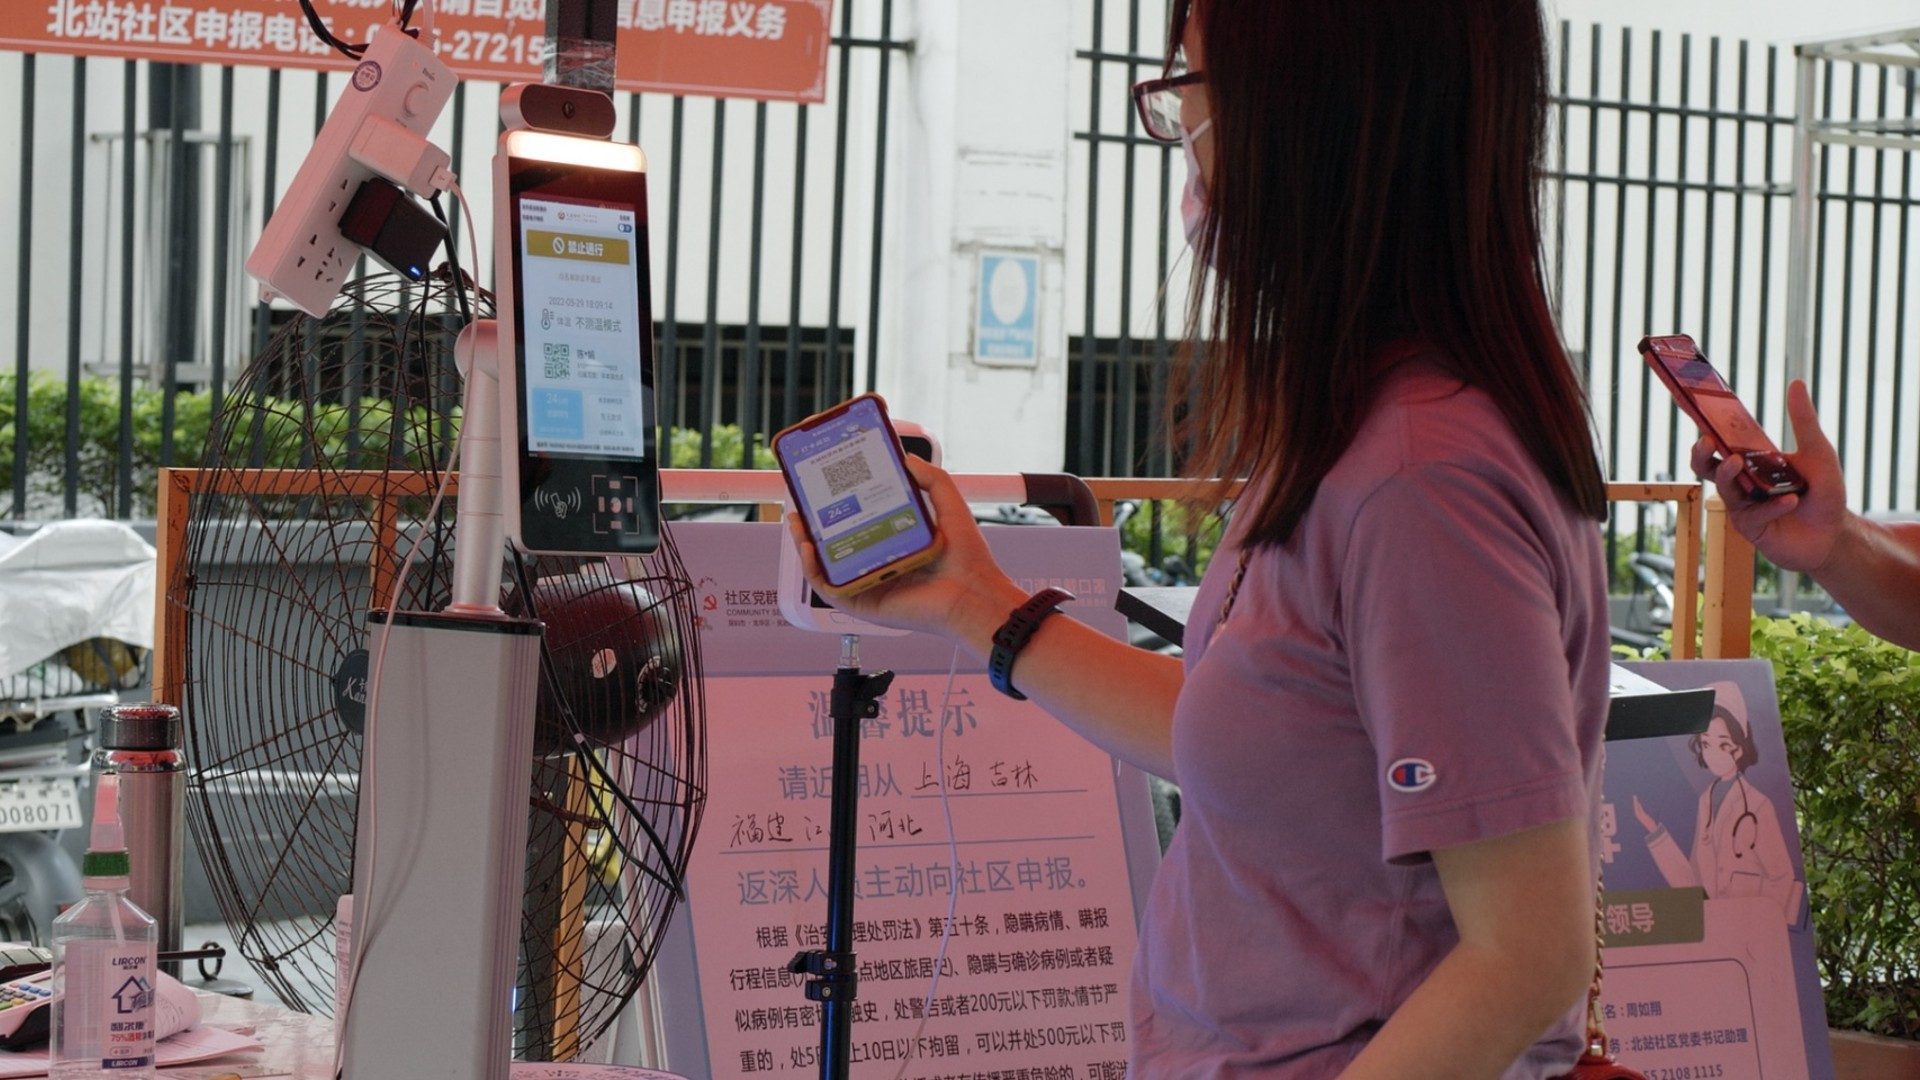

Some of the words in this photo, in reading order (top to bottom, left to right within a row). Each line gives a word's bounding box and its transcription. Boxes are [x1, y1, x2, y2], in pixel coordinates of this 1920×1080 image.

[726, 608, 770, 616] COMMUNITY
[914, 754, 971, 790] 上海
[989, 760, 1038, 789] 吉林
[730, 812, 794, 848] 福建
[868, 810, 923, 842] 河北
[112, 956, 146, 966] LIRCON
[1662, 1067, 1691, 1080] 2108
[1695, 1064, 1724, 1078] 1115
